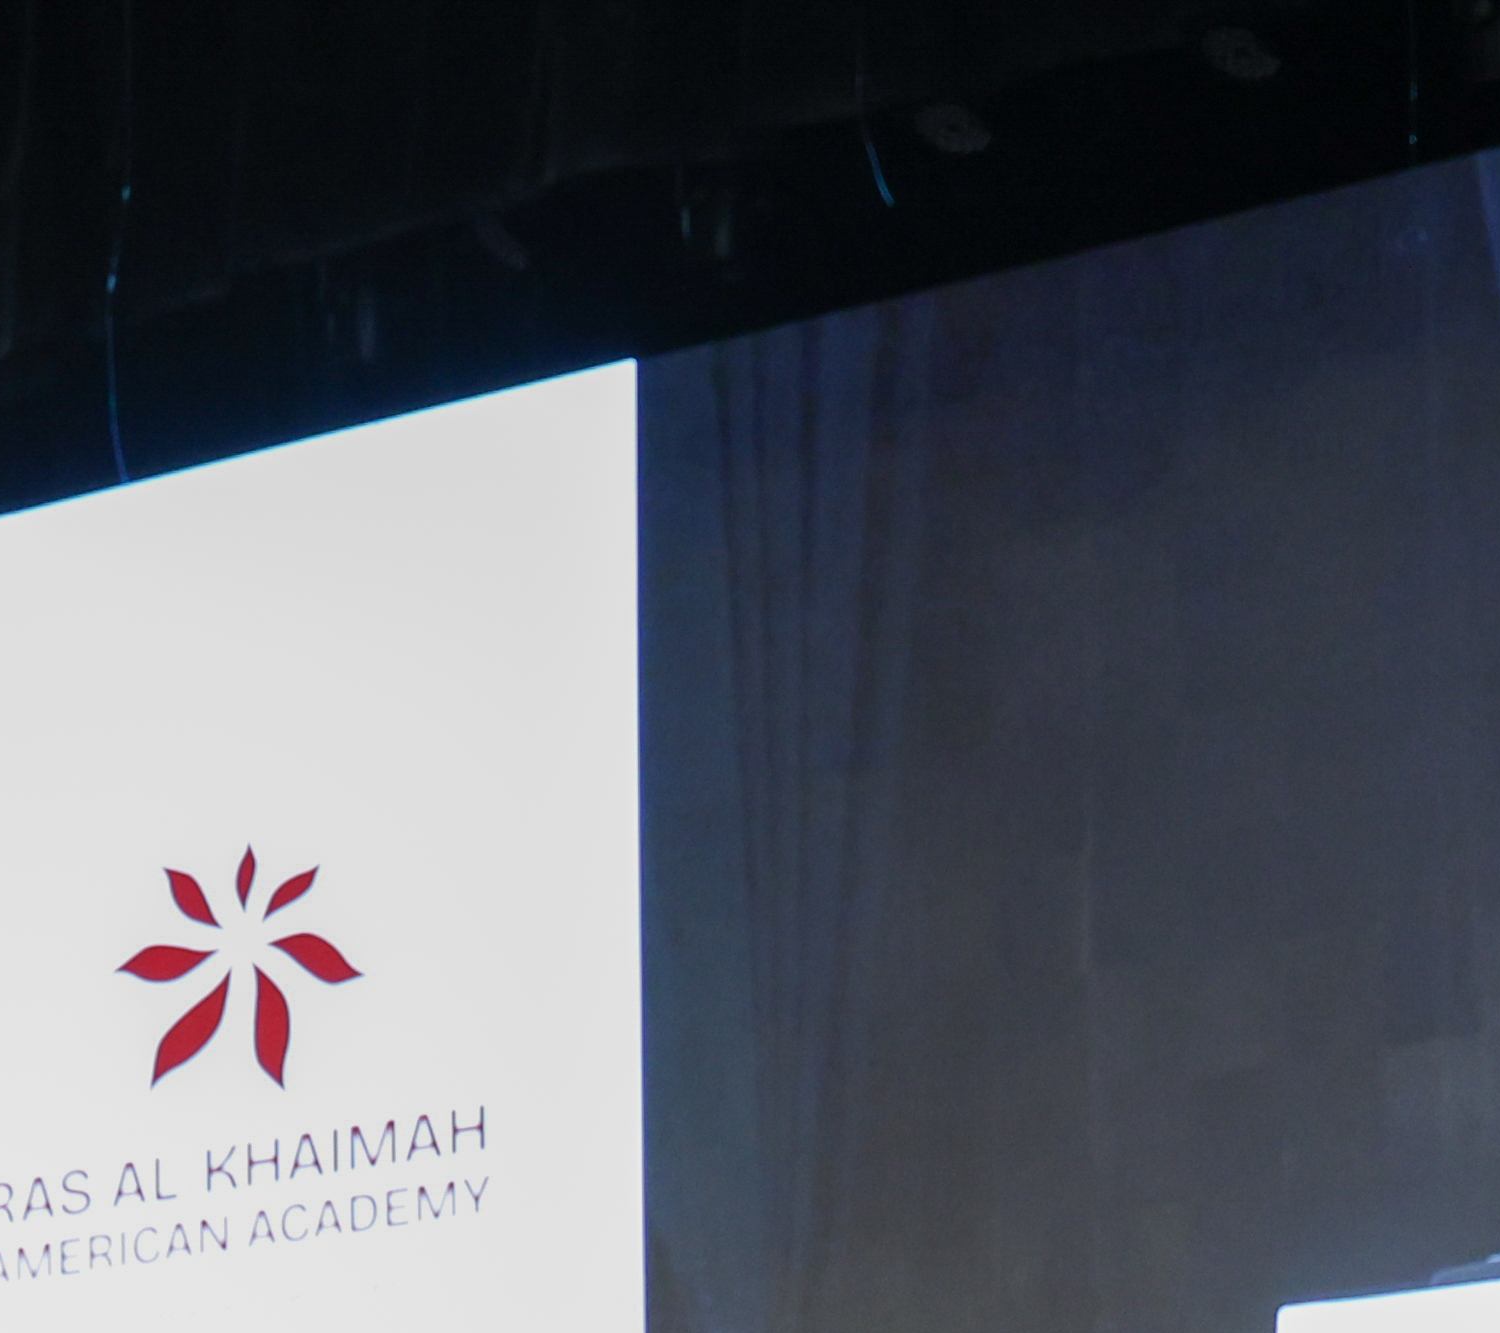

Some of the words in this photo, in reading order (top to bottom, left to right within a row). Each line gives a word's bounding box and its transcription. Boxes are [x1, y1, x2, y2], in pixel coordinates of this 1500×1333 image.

[113, 1158, 178, 1207] AL
[206, 1105, 486, 1192] KHAIMAH
[248, 1176, 490, 1248] ACADEMY
